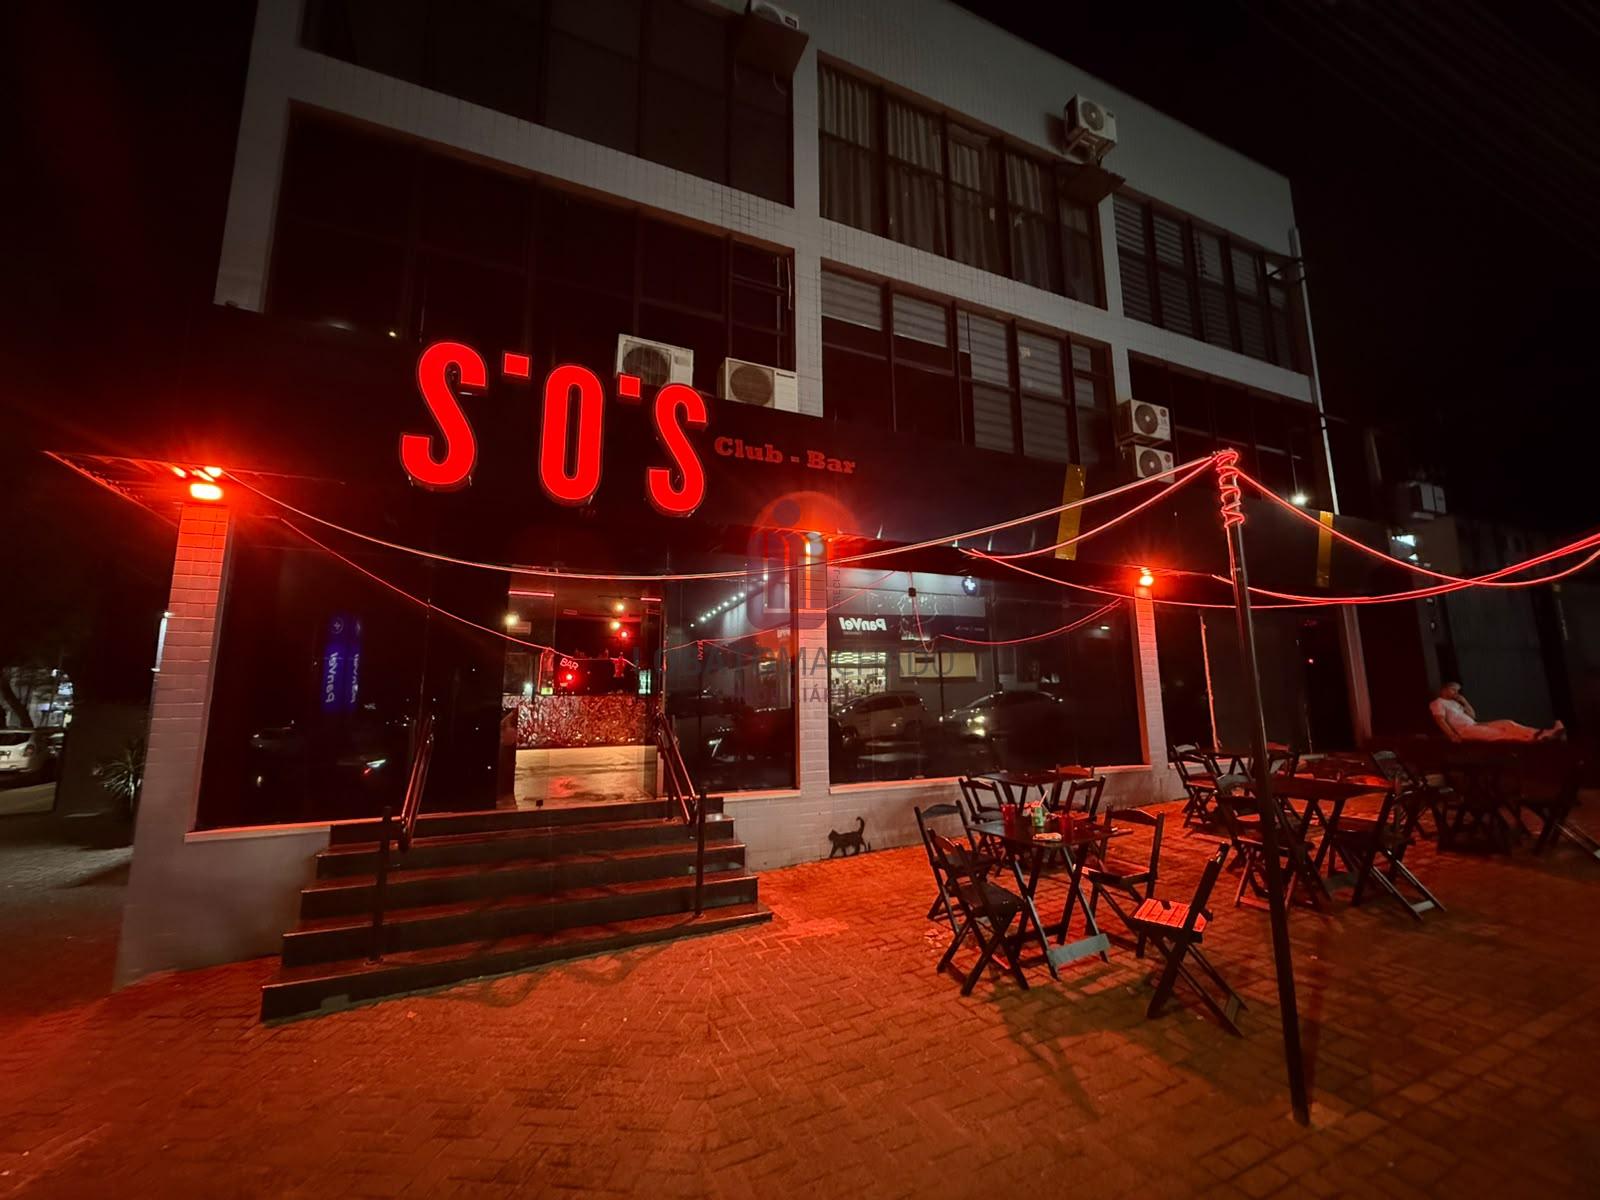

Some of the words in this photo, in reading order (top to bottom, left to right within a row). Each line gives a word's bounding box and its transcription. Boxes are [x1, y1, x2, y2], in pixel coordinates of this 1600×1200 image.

[714, 436, 784, 464] Club
[806, 450, 856, 474] Bar
[560, 657, 579, 671] BAR
